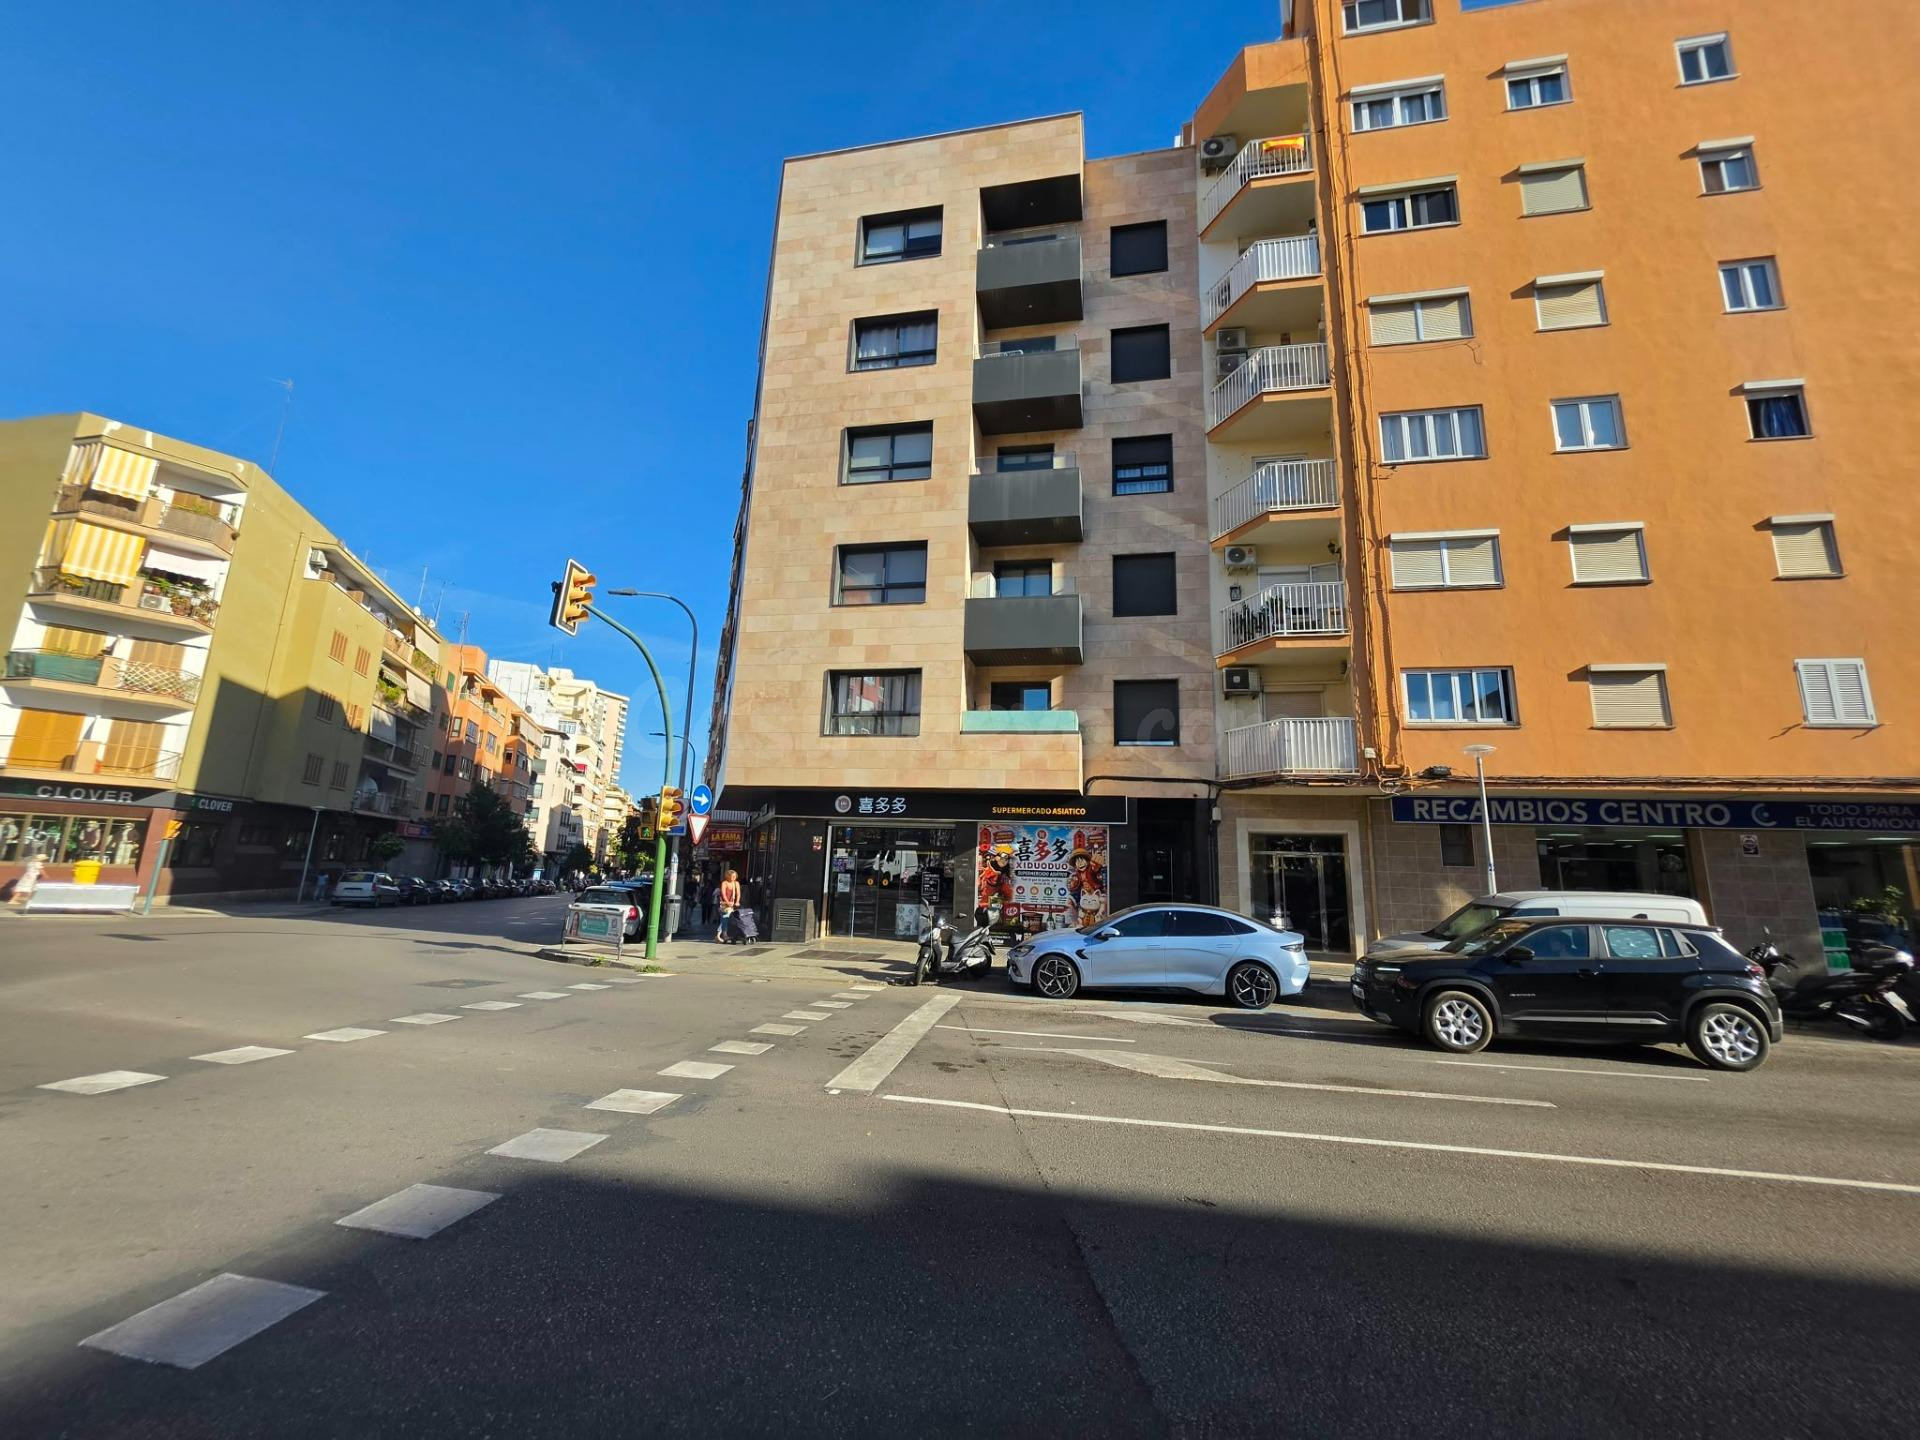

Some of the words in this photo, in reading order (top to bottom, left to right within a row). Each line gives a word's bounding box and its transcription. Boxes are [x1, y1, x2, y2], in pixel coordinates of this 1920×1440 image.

[36, 785, 134, 803] CLOVER
[198, 799, 233, 812] CLOVER
[858, 797, 907, 814] 喜多多
[992, 806, 1051, 815] SUPERMERCADO
[1052, 808, 1086, 816] ASIATICO
[1809, 804, 1859, 816] TODO
[1866, 805, 1913, 817] PARA
[1413, 799, 1588, 823] RECAMBIOS
[1599, 801, 1731, 826] CENTRO
[1795, 816, 1815, 827] EL
[1015, 837, 1068, 862] 喜多多
[1016, 862, 1068, 870] XIDUODUO
